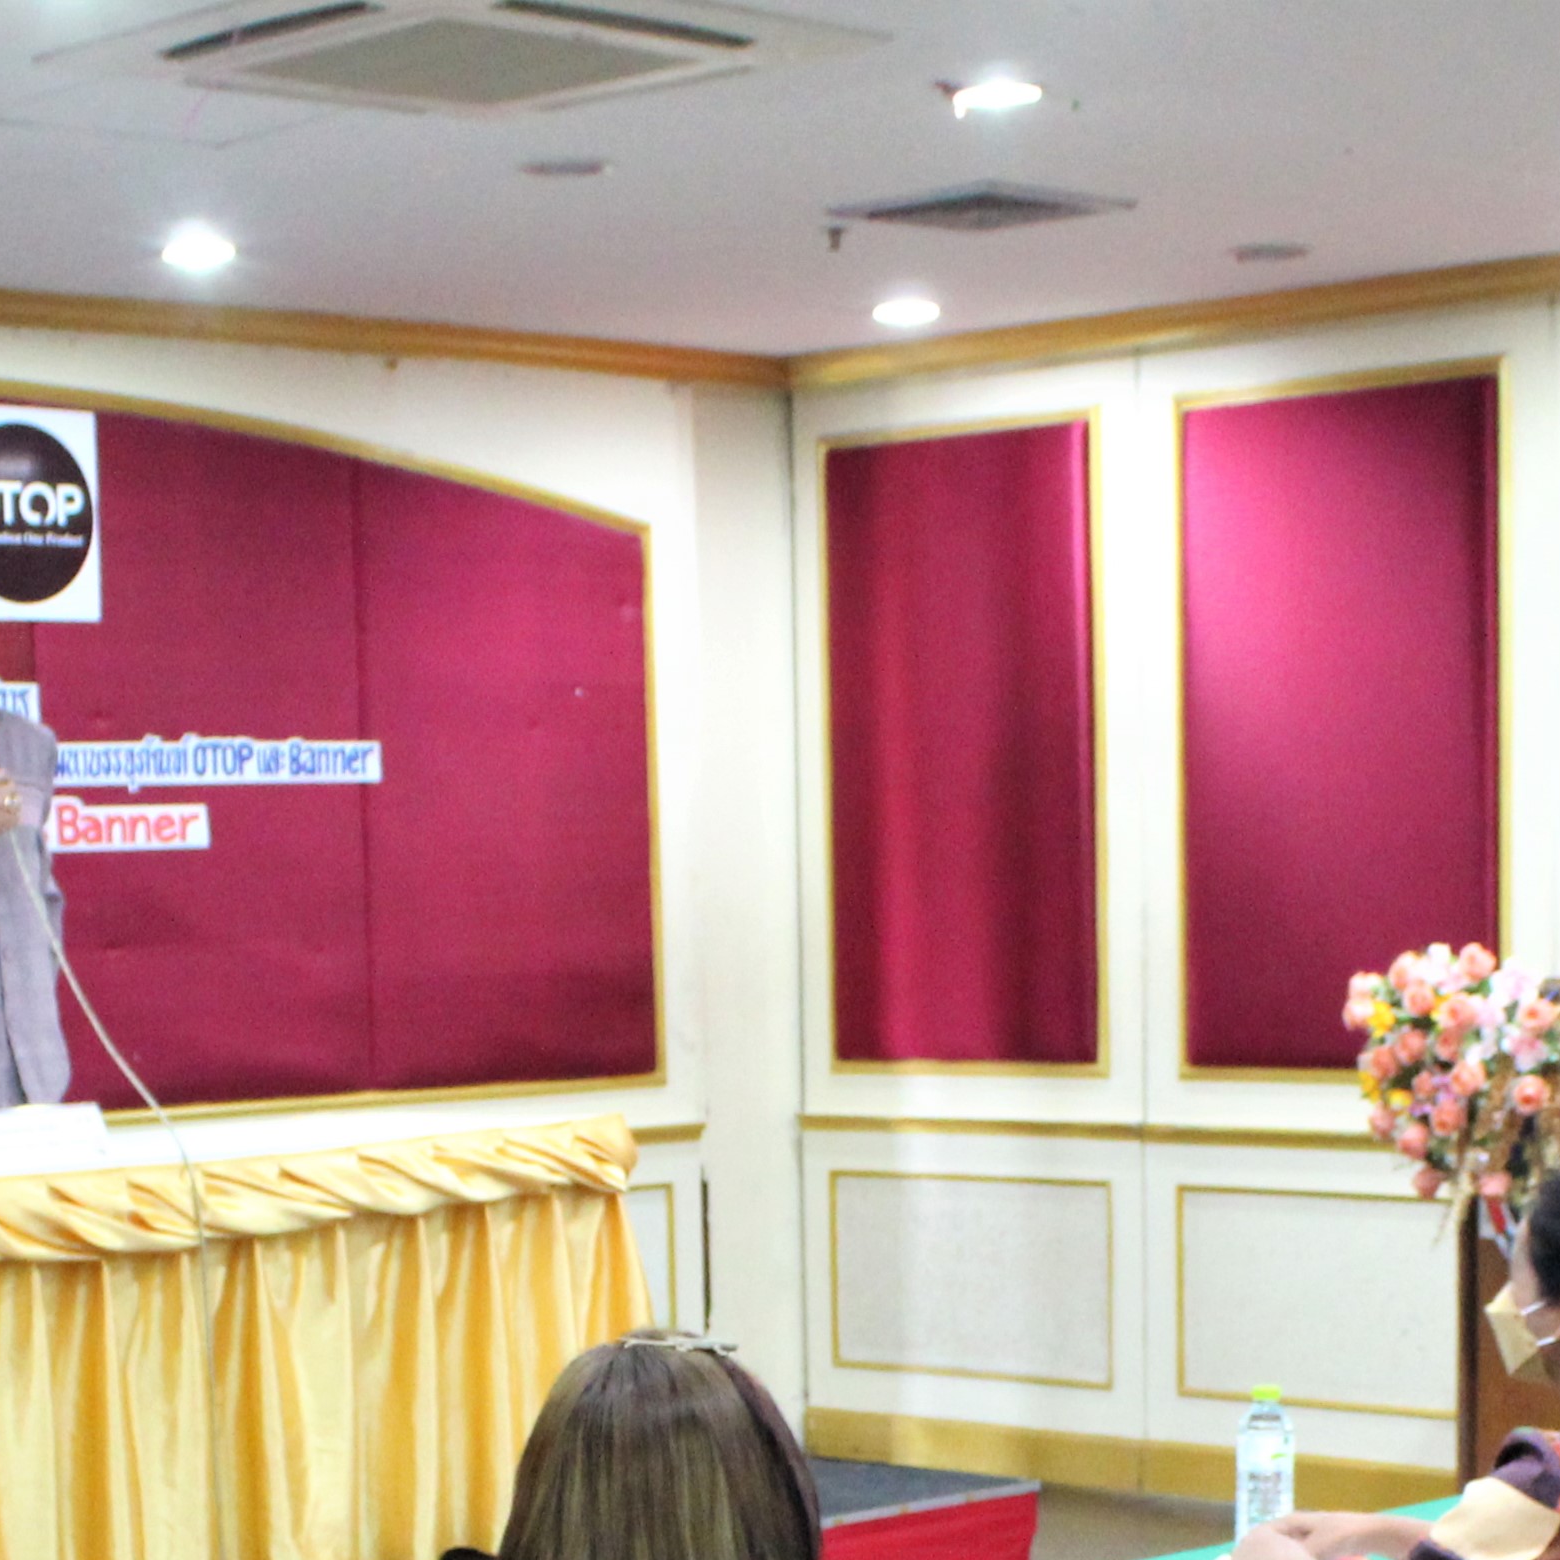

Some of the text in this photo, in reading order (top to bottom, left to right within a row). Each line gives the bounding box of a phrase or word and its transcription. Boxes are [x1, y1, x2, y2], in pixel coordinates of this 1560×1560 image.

[193, 743, 254, 776] OTOP
[288, 743, 374, 776] Banner
[56, 804, 200, 847] Banner
